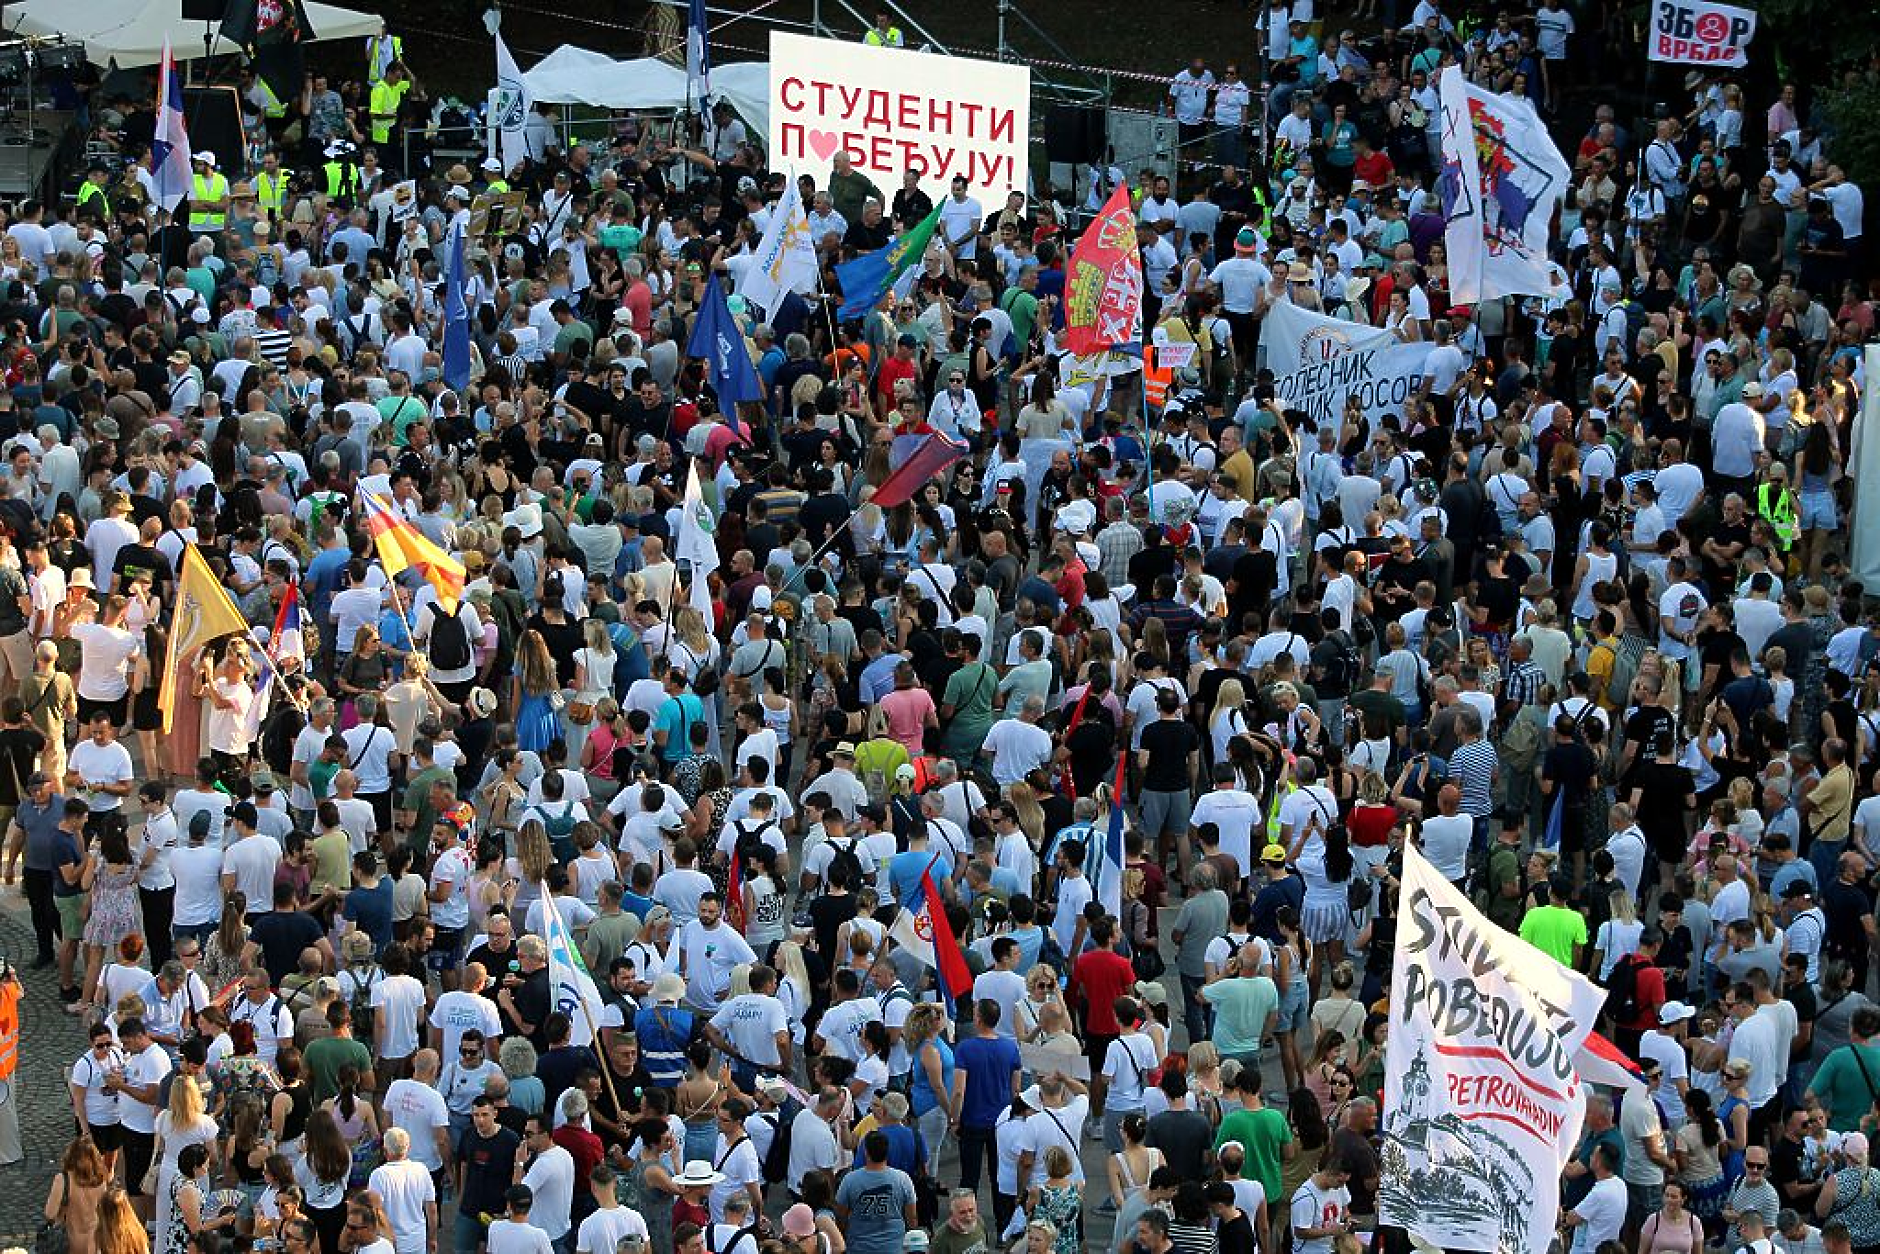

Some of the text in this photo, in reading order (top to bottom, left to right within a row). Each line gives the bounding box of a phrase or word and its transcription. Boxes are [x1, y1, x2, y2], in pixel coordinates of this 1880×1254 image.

[781, 77, 1014, 143] СТУДЕНТИ
[1274, 351, 1375, 401] ОЛЕСНИК
[1345, 374, 1422, 411] КОСОВ
